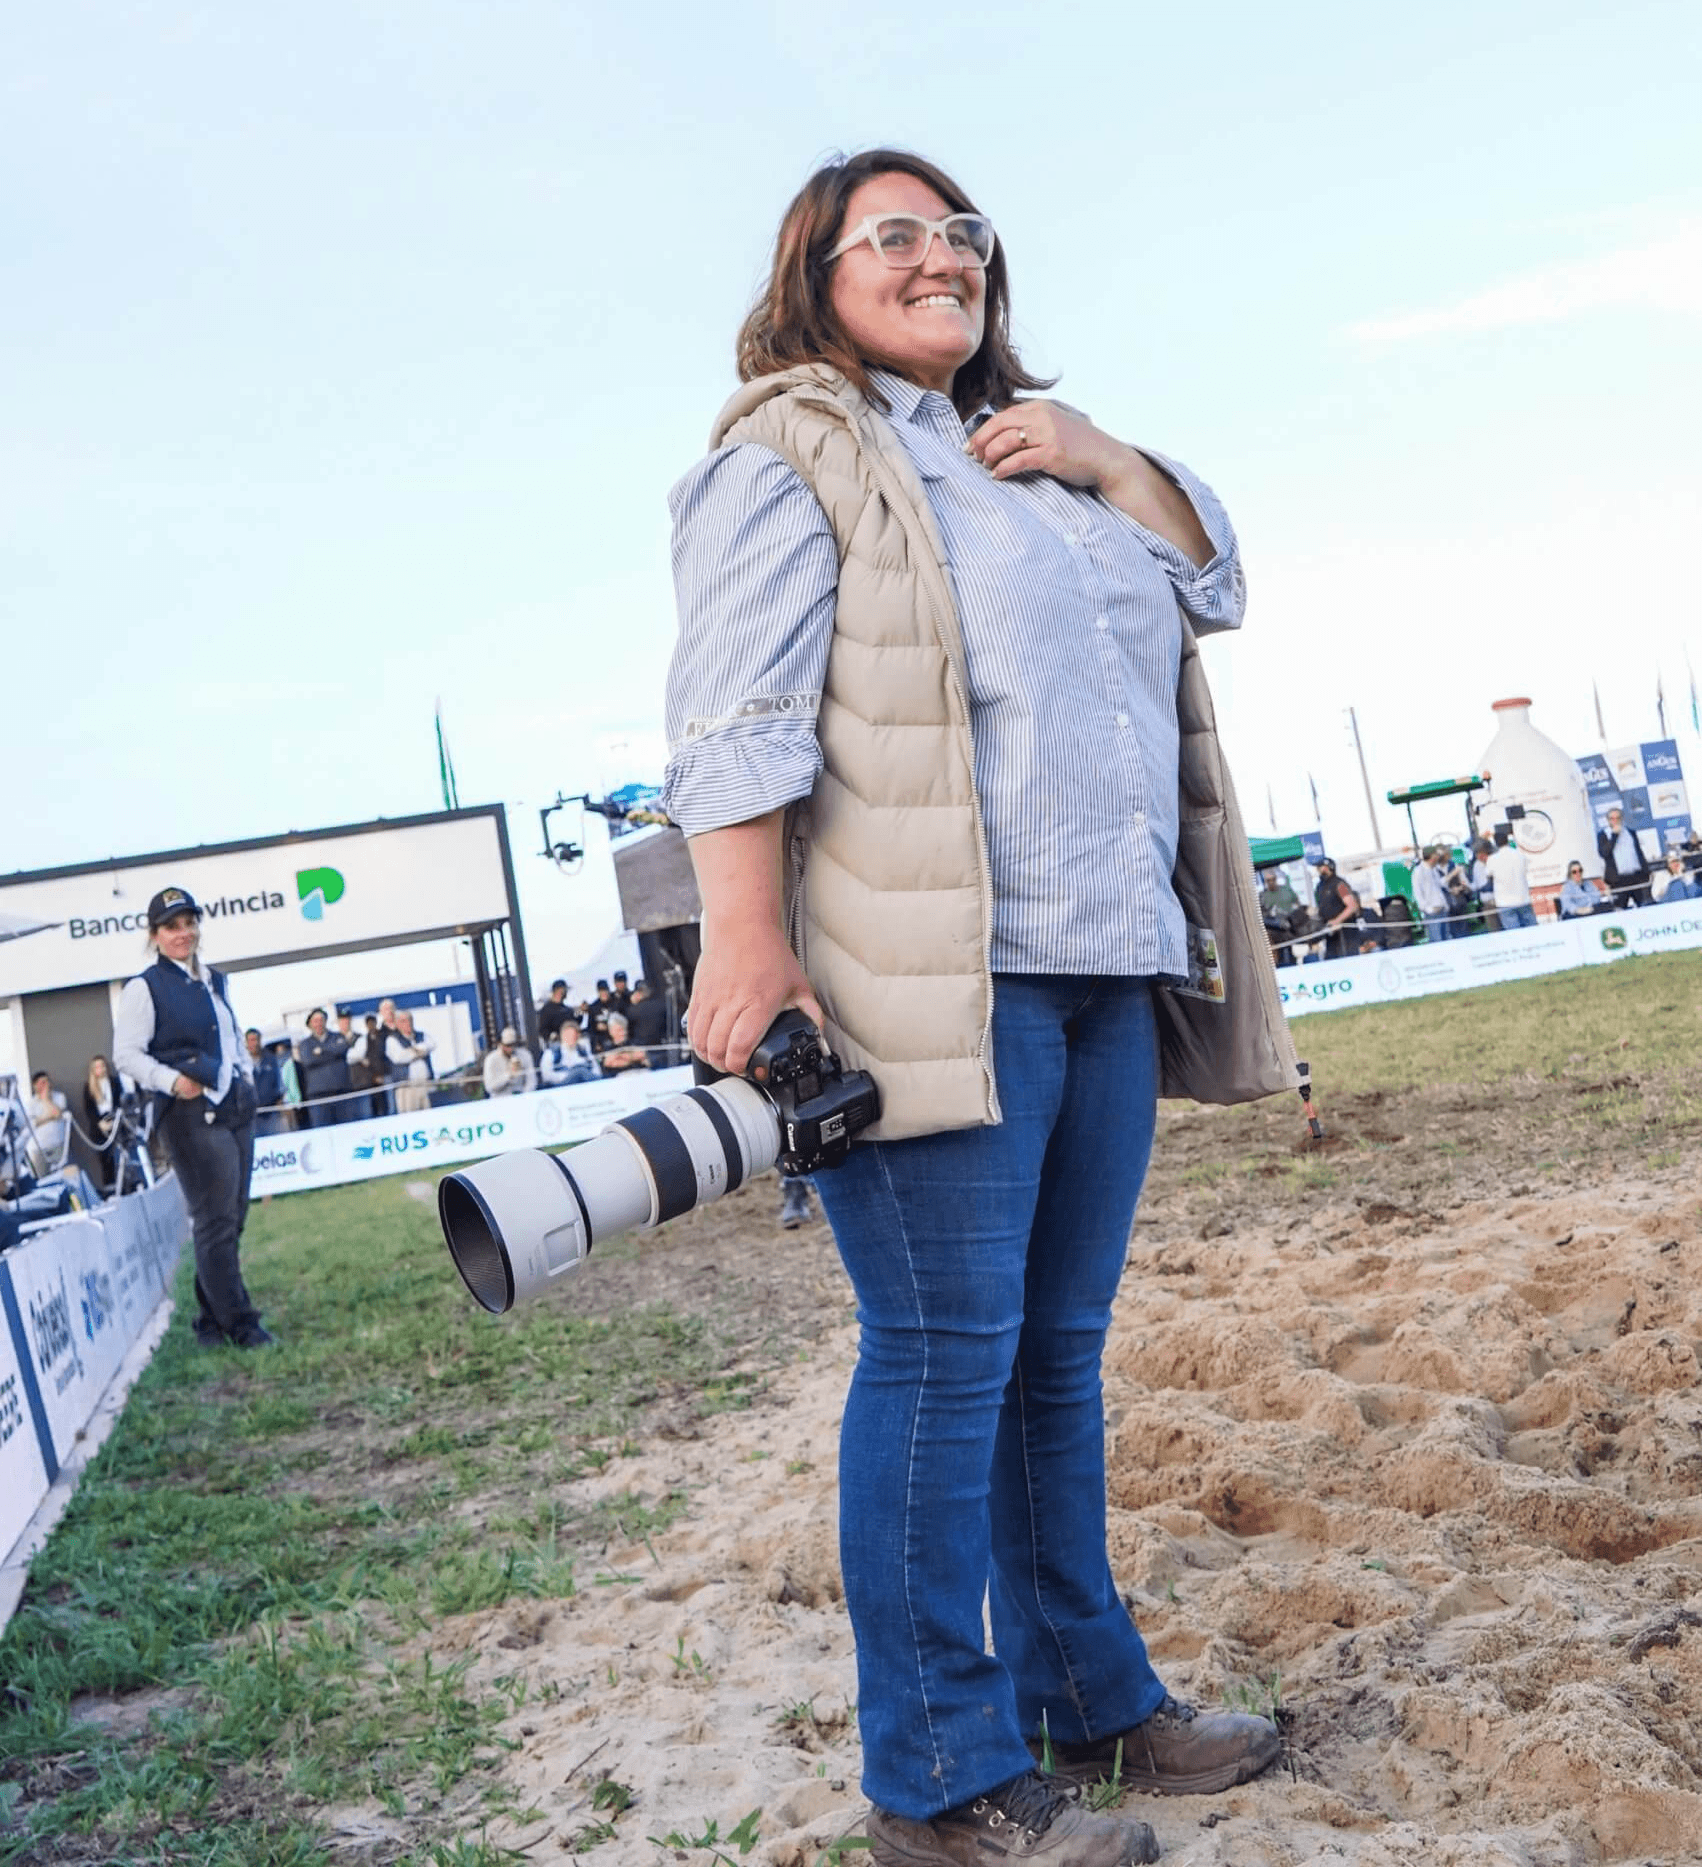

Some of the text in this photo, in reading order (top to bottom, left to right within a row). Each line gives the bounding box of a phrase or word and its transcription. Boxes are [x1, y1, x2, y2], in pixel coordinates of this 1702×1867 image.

[769, 695, 817, 712] TOM
[69, 890, 285, 939] Banco vincia
[1636, 924, 1678, 941] JOHN
[1293, 979, 1353, 1001] Agro
[381, 1122, 504, 1155] RUS Agro
